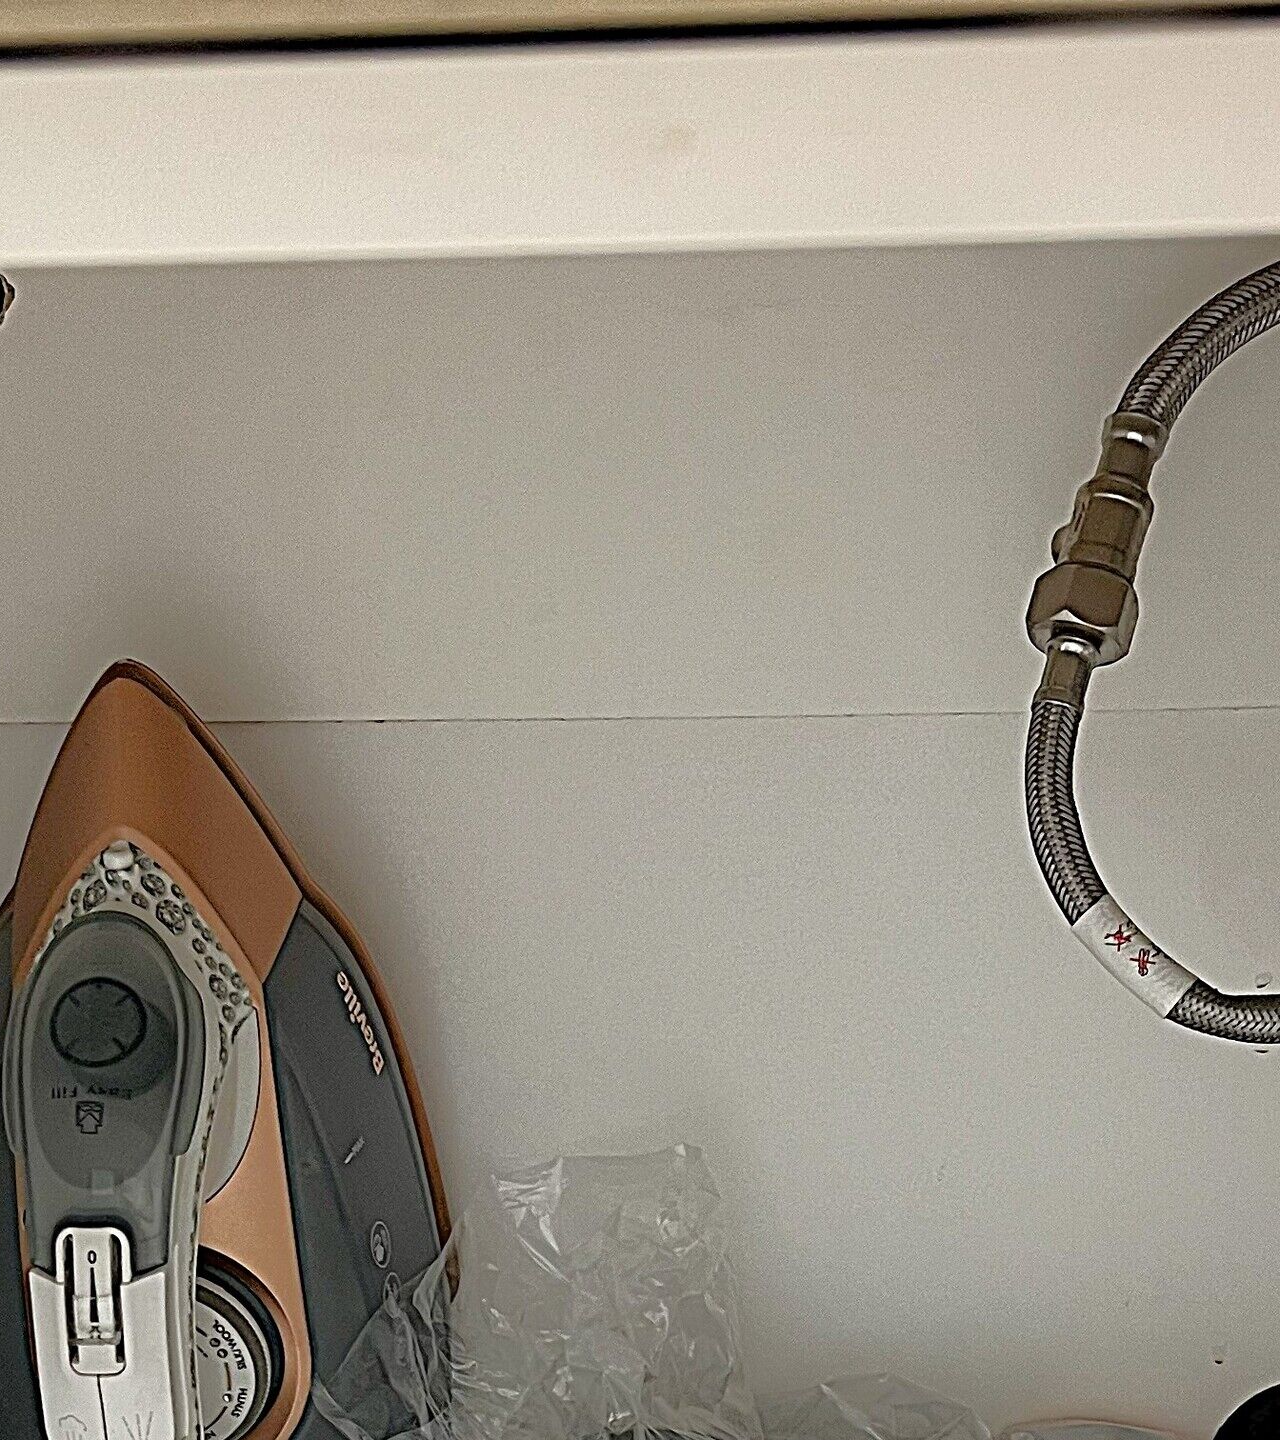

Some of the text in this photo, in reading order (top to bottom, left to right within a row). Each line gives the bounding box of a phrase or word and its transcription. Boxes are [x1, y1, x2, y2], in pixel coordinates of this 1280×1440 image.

[336, 971, 385, 1076] Breville
[51, 1086, 78, 1099] Fill
[231, 1387, 248, 1419] SYNTH
